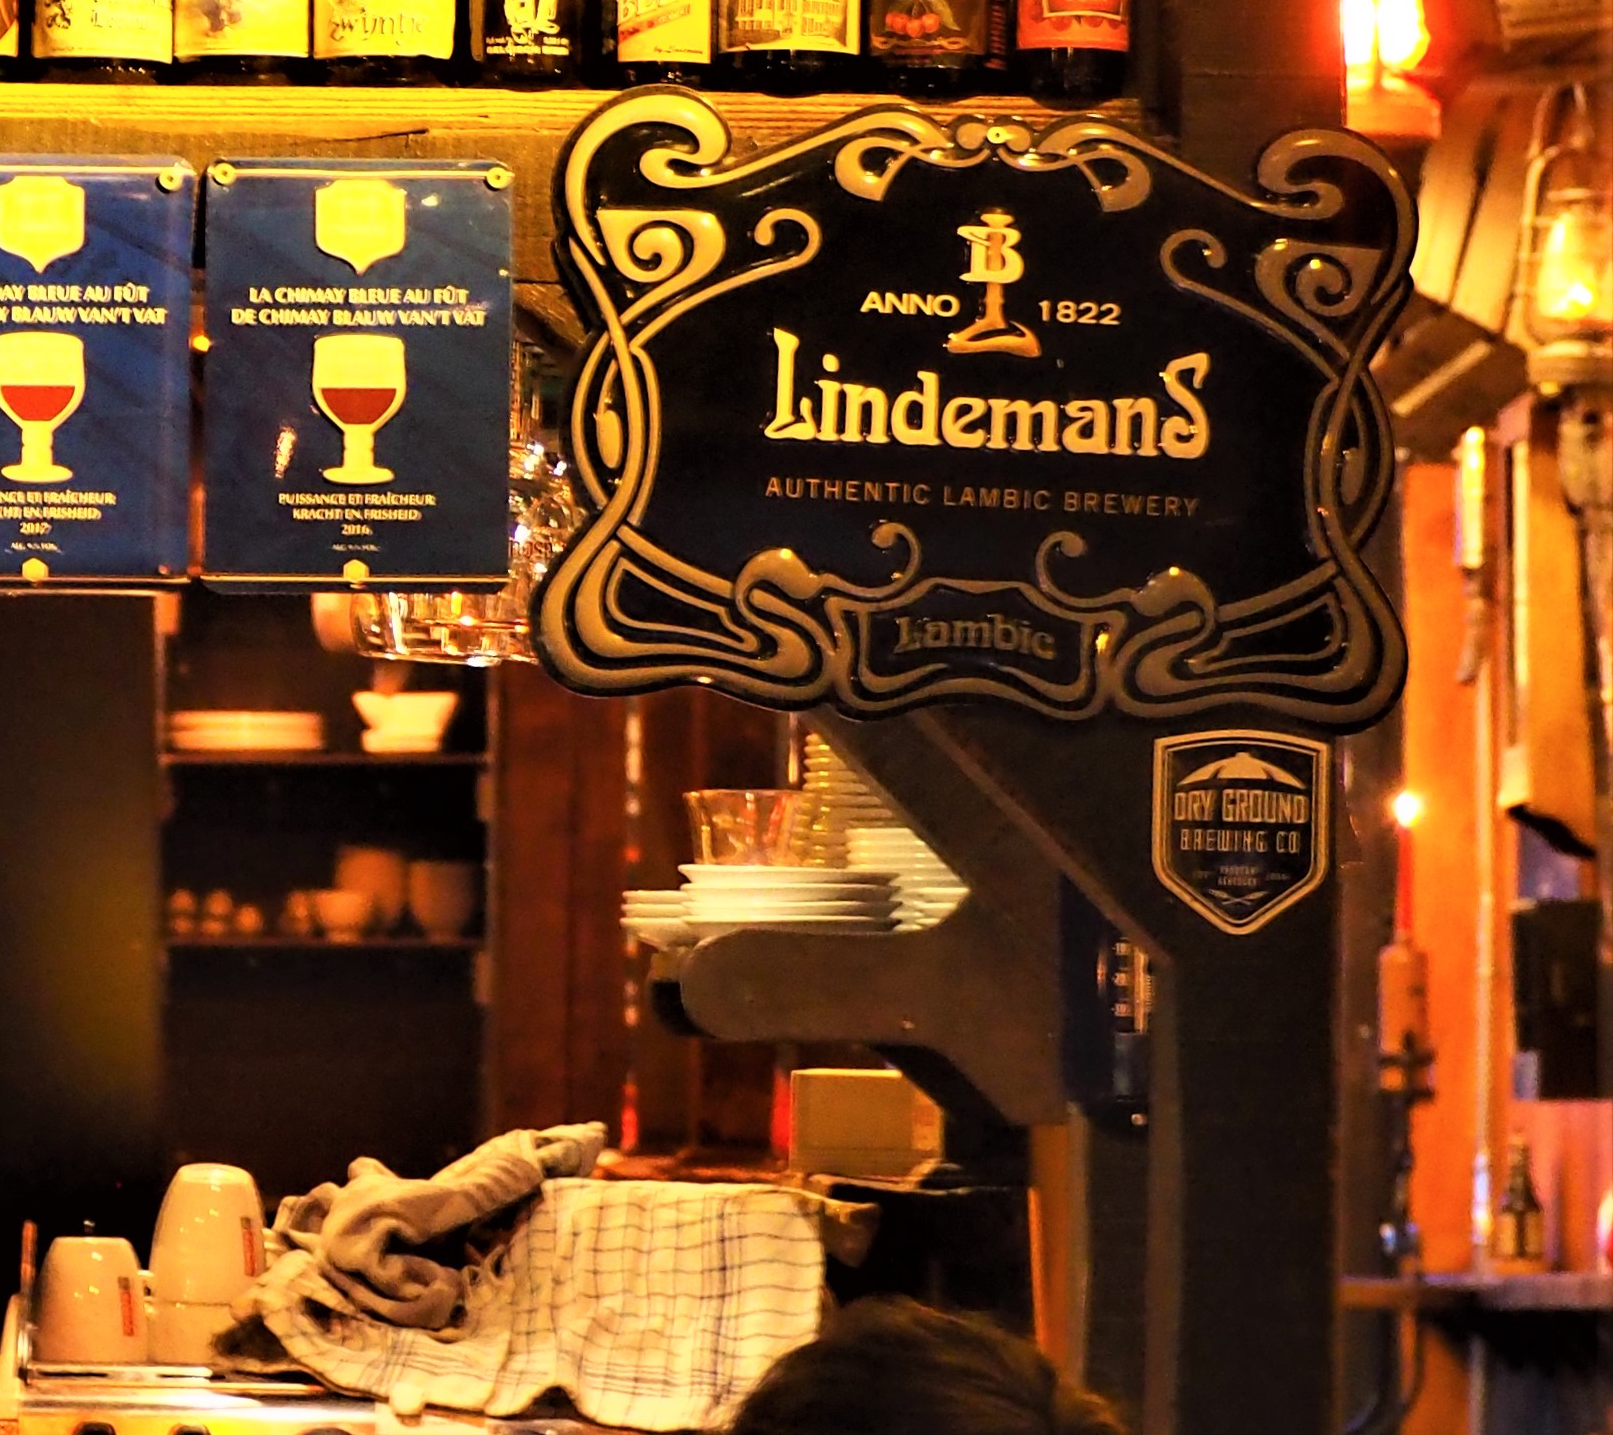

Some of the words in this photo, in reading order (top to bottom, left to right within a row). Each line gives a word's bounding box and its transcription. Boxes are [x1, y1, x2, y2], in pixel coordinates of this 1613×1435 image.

[27, 284, 82, 302] BLEUE
[83, 285, 112, 303] AU
[249, 286, 273, 304] LA
[274, 286, 346, 304] CHIMAY
[348, 286, 402, 305] BLEUE
[403, 287, 431, 305] AU
[11, 306, 78, 324] BLAUW
[134, 308, 168, 326] VAT
[230, 308, 257, 326] DE
[258, 308, 329, 326] CHIMAY
[332, 309, 397, 327] BLAUW
[453, 308, 487, 327] VAT
[859, 290, 961, 318] ANNO
[1037, 299, 1122, 326] 1822
[764, 475, 931, 506] AUTHENTIC
[943, 485, 1052, 511] LAMBIC
[1062, 491, 1201, 518] BREWERY
[893, 613, 1058, 661] Lambic
[1173, 790, 1215, 822] DRY
[1221, 788, 1310, 824] GROUND
[1180, 828, 1268, 853] BREWING
[1275, 830, 1300, 854] CO
